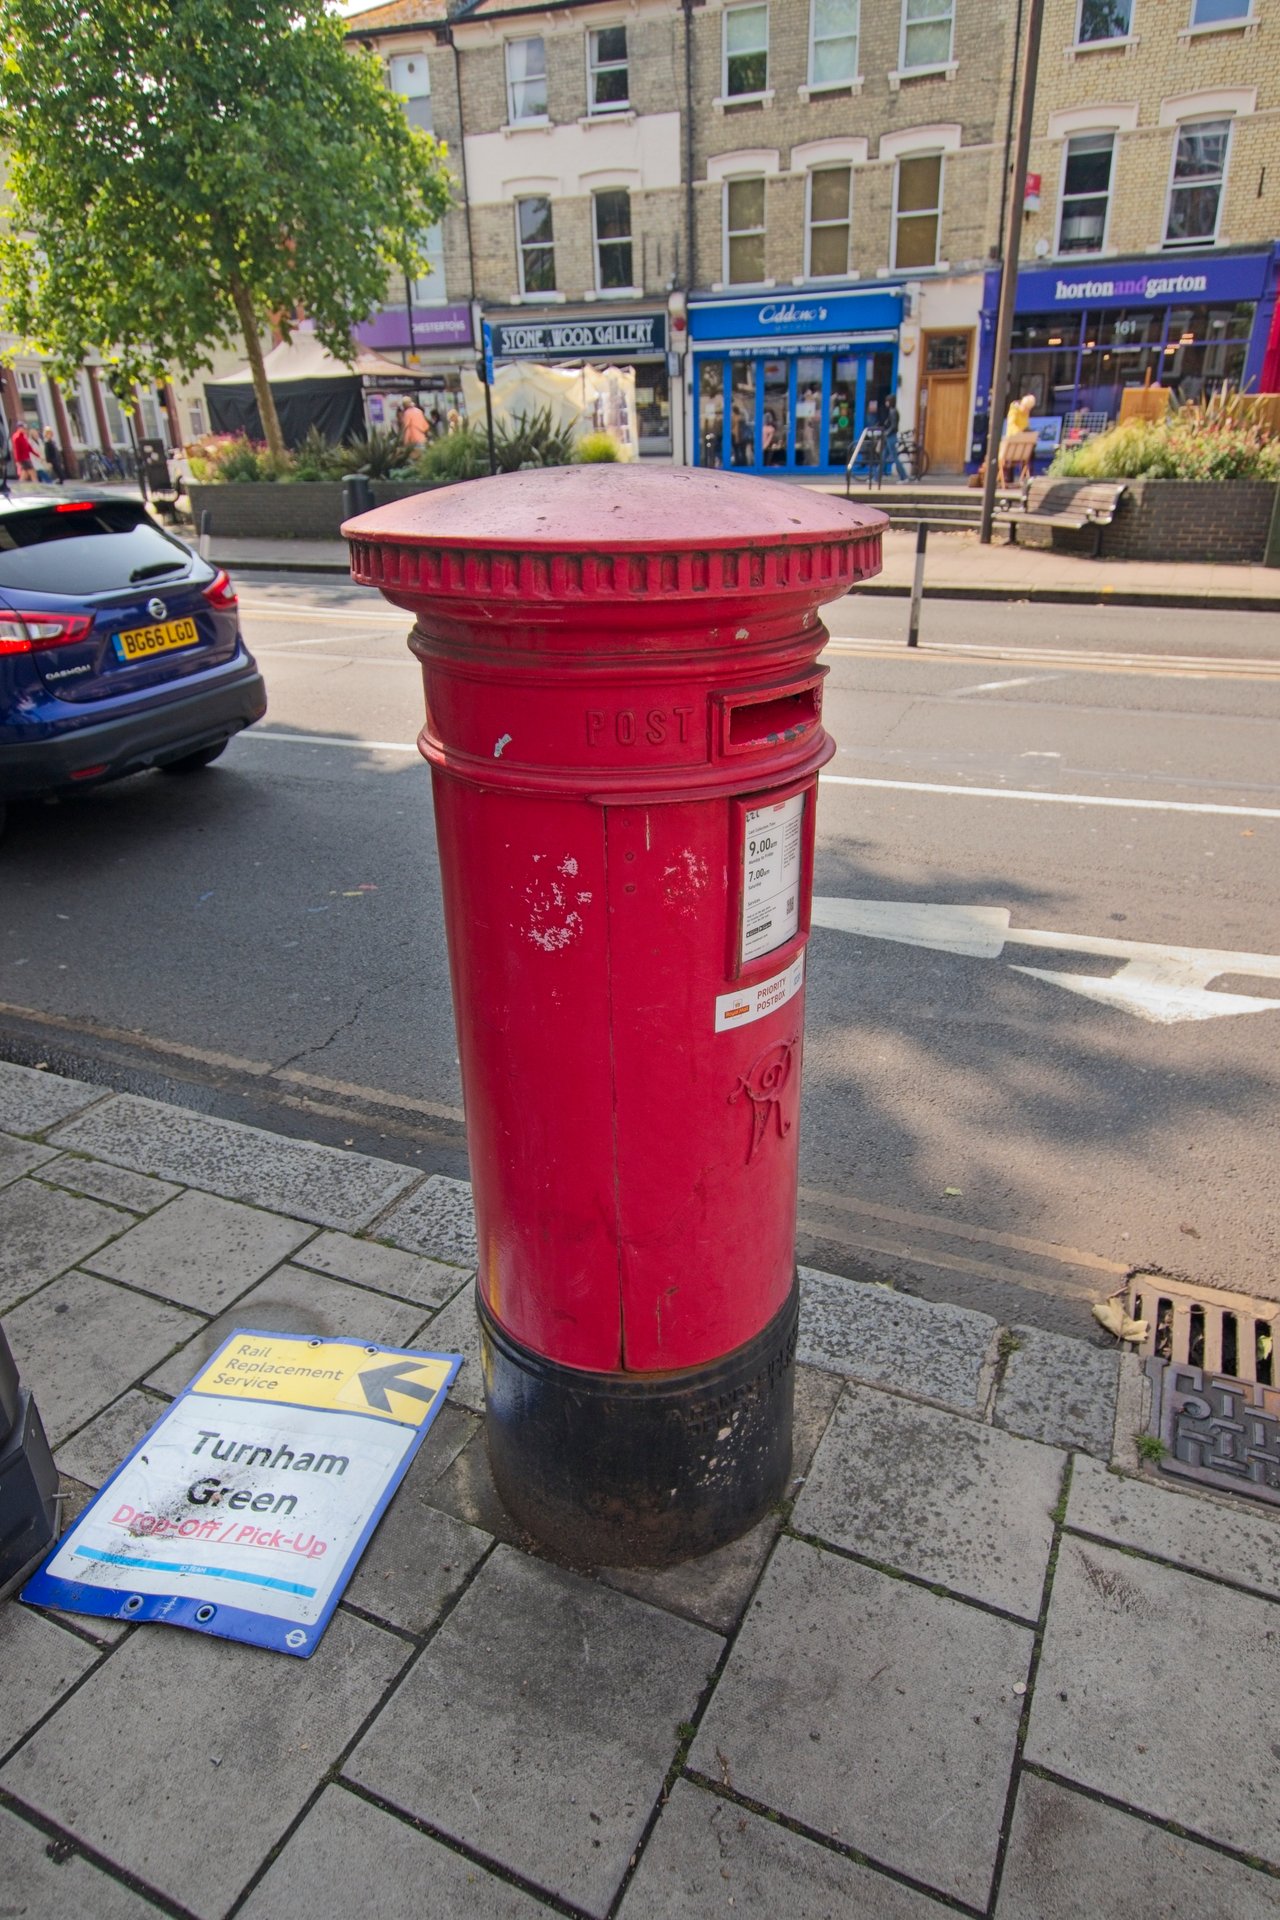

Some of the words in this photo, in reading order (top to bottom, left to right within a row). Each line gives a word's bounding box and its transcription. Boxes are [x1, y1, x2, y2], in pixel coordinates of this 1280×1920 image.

[501, 329, 545, 350] STONE
[550, 326, 594, 347] WOOD
[594, 322, 654, 345] GALLERY
[1114, 320, 1137, 335] 161
[125, 629, 165, 653] BG66
[167, 621, 195, 643] LGD
[585, 706, 695, 747] POST
[756, 988, 786, 1012] POSTBOX
[757, 976, 787, 1000] PRIORITY
[237, 1344, 272, 1357] Rail
[212, 1372, 278, 1390] Service
[225, 1358, 344, 1381] Replacement
[191, 1430, 350, 1476] Turnham
[187, 1477, 298, 1515] Green
[111, 1504, 223, 1538] Drop-Off
[217, 1522, 238, 1542] /
[235, 1525, 327, 1559] Pick-Up
